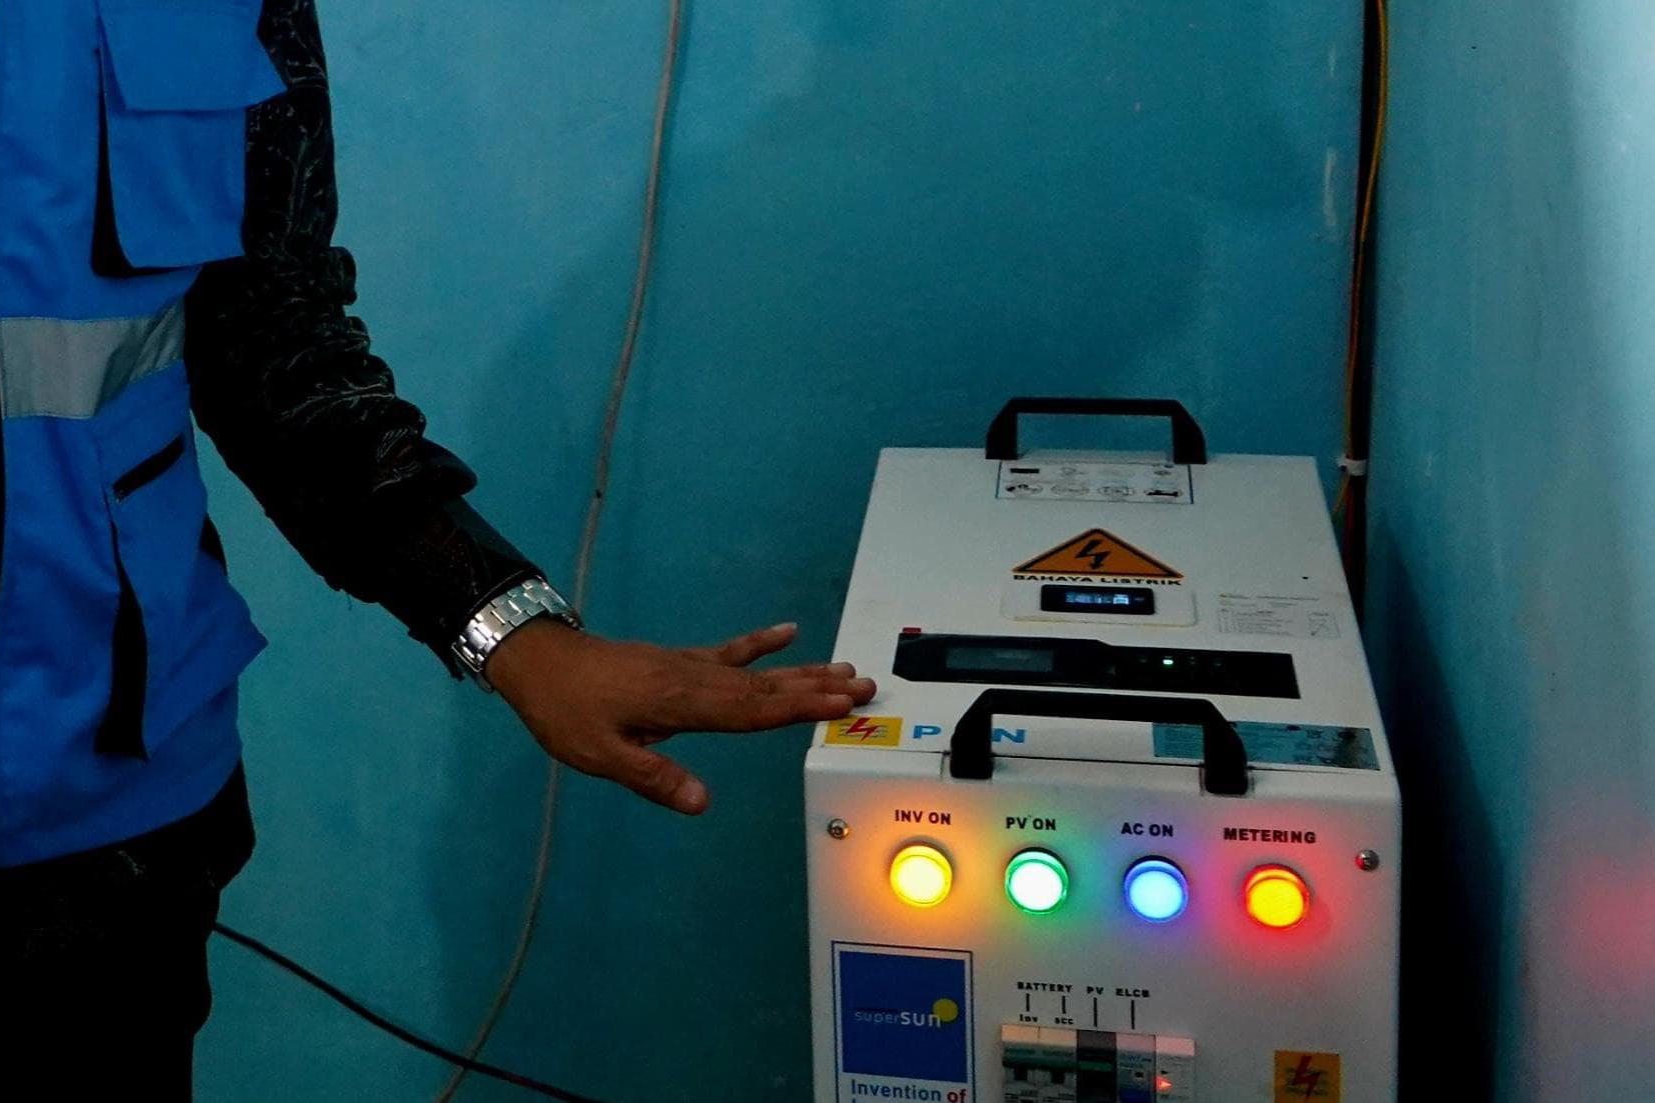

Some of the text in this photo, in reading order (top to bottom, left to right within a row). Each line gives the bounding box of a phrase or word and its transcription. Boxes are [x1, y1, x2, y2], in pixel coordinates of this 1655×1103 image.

[1013, 574, 1182, 586] BAHAYA LISTRIK
[913, 725, 1025, 743] PN
[895, 809, 951, 825] INV ON
[1005, 816, 1056, 831] PV ON
[1121, 822, 1173, 837] AC ON
[1223, 827, 1316, 844] METERING
[1017, 981, 1150, 998] BATTERY PV ELCB
[851, 1079, 966, 1103] Invention of
